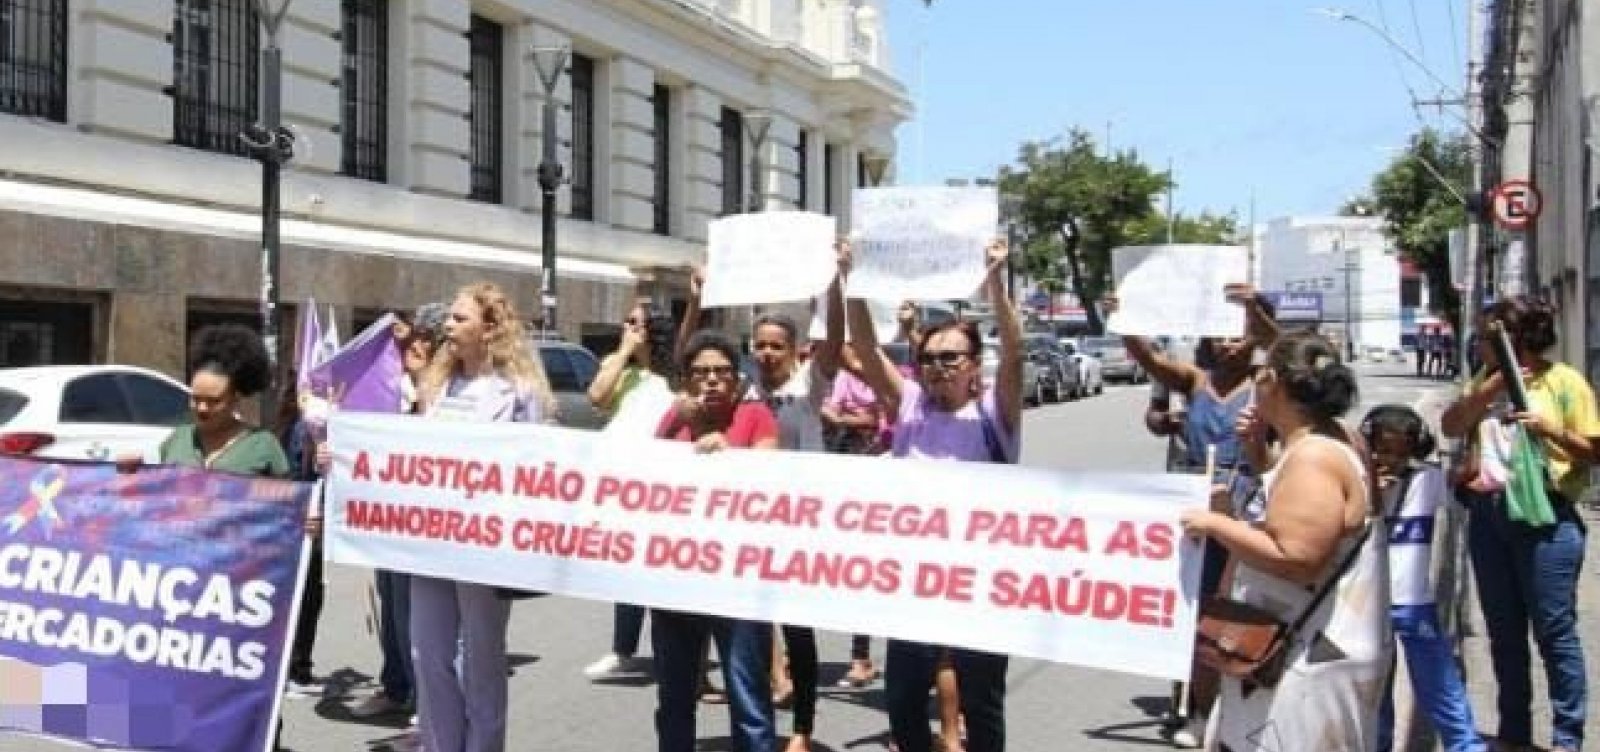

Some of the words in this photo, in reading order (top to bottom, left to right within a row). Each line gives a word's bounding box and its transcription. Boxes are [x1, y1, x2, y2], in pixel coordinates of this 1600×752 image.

[1505, 191, 1524, 217] E
[352, 451, 371, 480] A
[378, 453, 504, 498] JUSTIÇA
[512, 462, 585, 502] NÃO
[594, 476, 694, 515] PODE
[705, 488, 823, 529] FICAR
[834, 501, 950, 540] CEGA
[964, 510, 1090, 553] PARA
[1103, 520, 1175, 561] AS
[0, 543, 276, 627] CRIANÇAS
[344, 500, 505, 549] MANOBRAS
[510, 519, 636, 564] CRUÉIS
[645, 535, 723, 573] DOS
[734, 545, 902, 595] PLANOS
[913, 562, 976, 602] DE
[989, 569, 1178, 628] SAÚDE!
